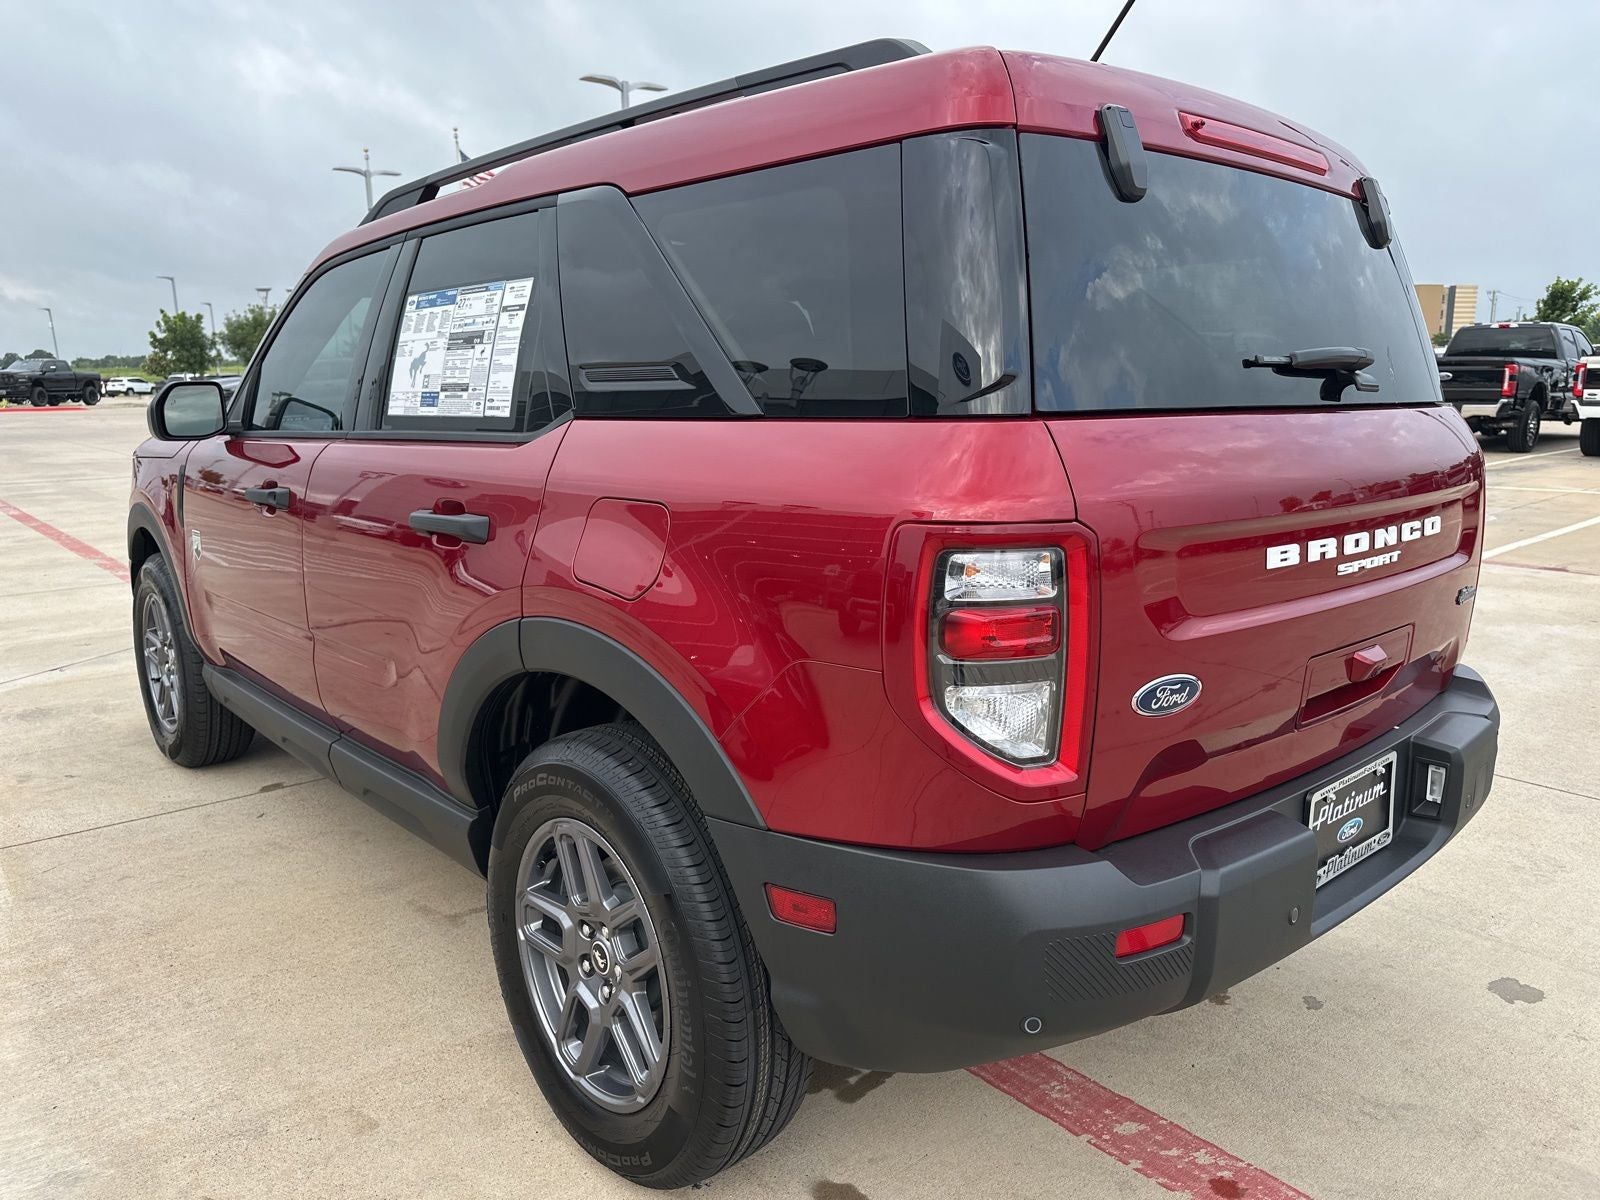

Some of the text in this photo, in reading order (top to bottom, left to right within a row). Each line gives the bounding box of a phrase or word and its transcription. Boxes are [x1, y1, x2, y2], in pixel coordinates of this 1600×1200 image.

[1266, 515, 1441, 570] BRONCO
[1337, 550, 1401, 576] SPORT
[1151, 683, 1190, 710] Ford
[1320, 756, 1390, 798] www.PlatinumFord.com
[1312, 781, 1388, 831] Platinum
[1325, 842, 1376, 878] Platinum
